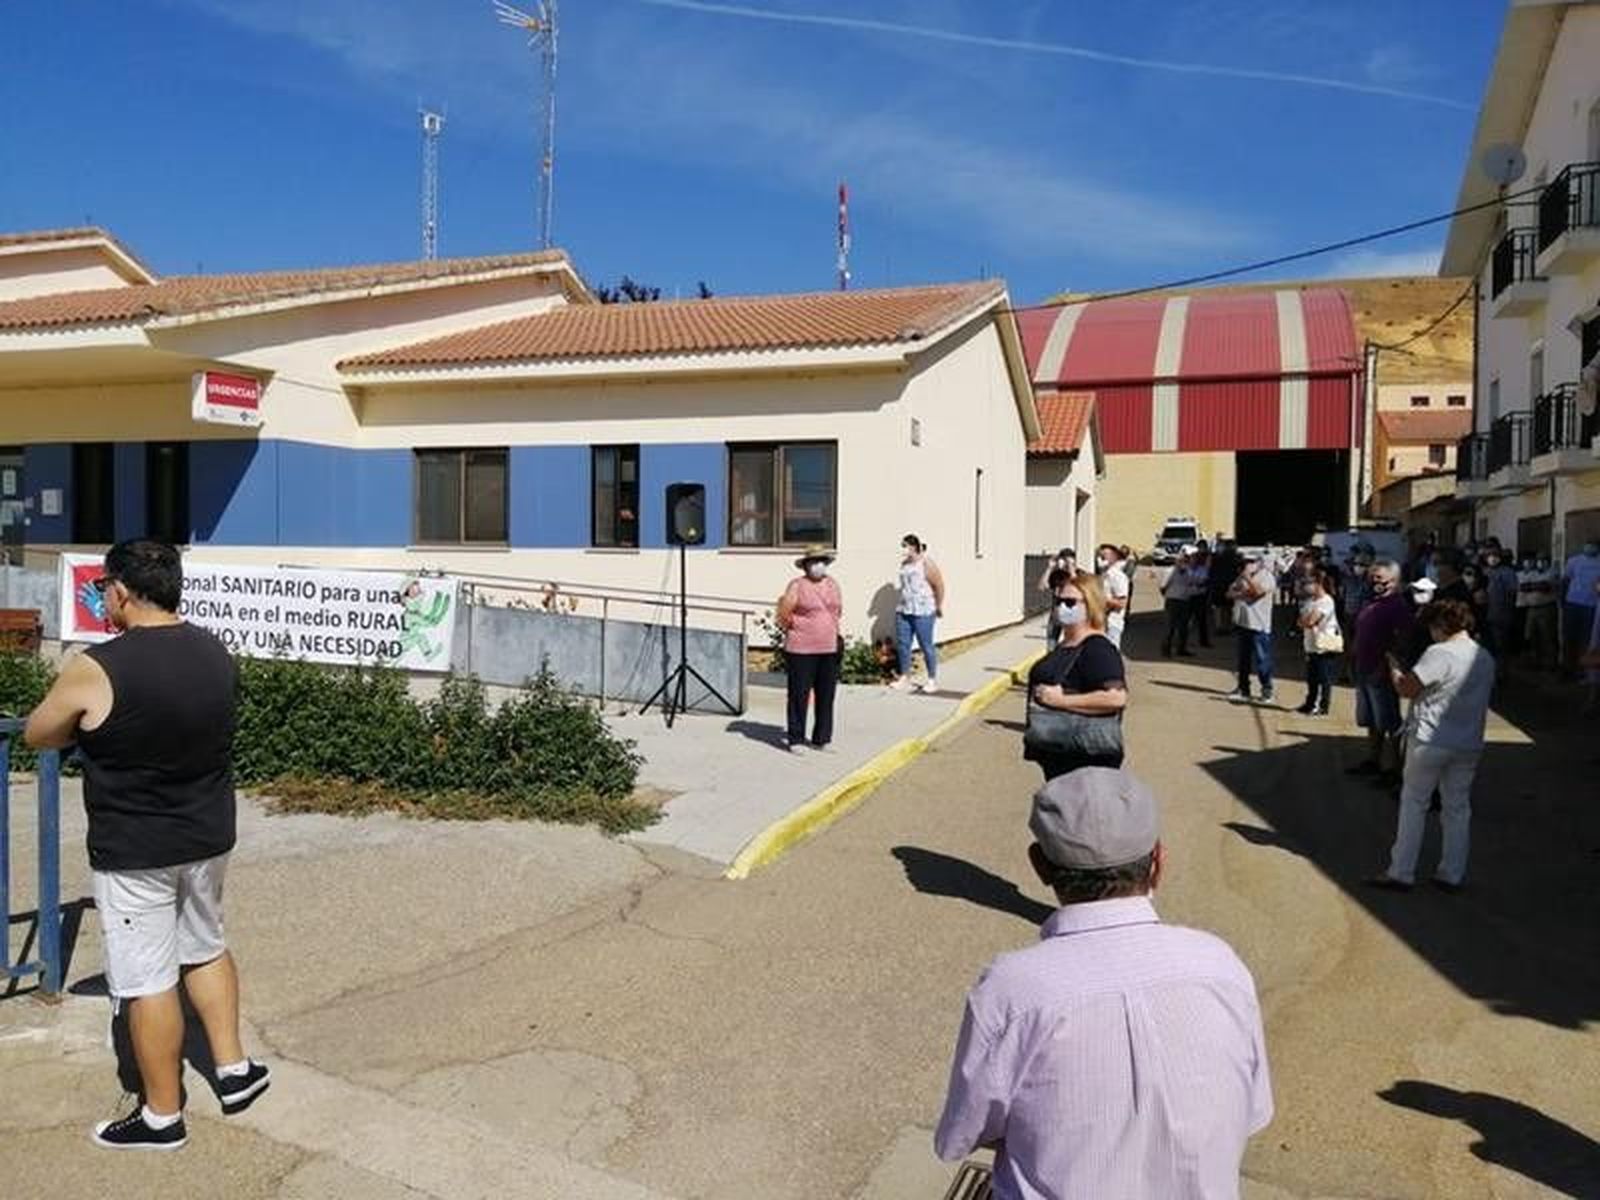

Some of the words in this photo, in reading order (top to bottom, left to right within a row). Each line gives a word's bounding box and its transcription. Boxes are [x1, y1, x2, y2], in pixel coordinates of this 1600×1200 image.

[181, 575, 217, 592] onal
[221, 576, 317, 599] SANITARIO
[321, 586, 361, 604] para
[367, 590, 401, 605] una
[180, 599, 233, 619] DIGNA
[238, 607, 260, 621] en
[264, 605, 280, 623] el
[285, 608, 342, 628] medio
[347, 611, 410, 632] RURAL
[239, 630, 249, 646] Y
[254, 629, 294, 651] UNA
[300, 634, 403, 659] NECESIDAD
